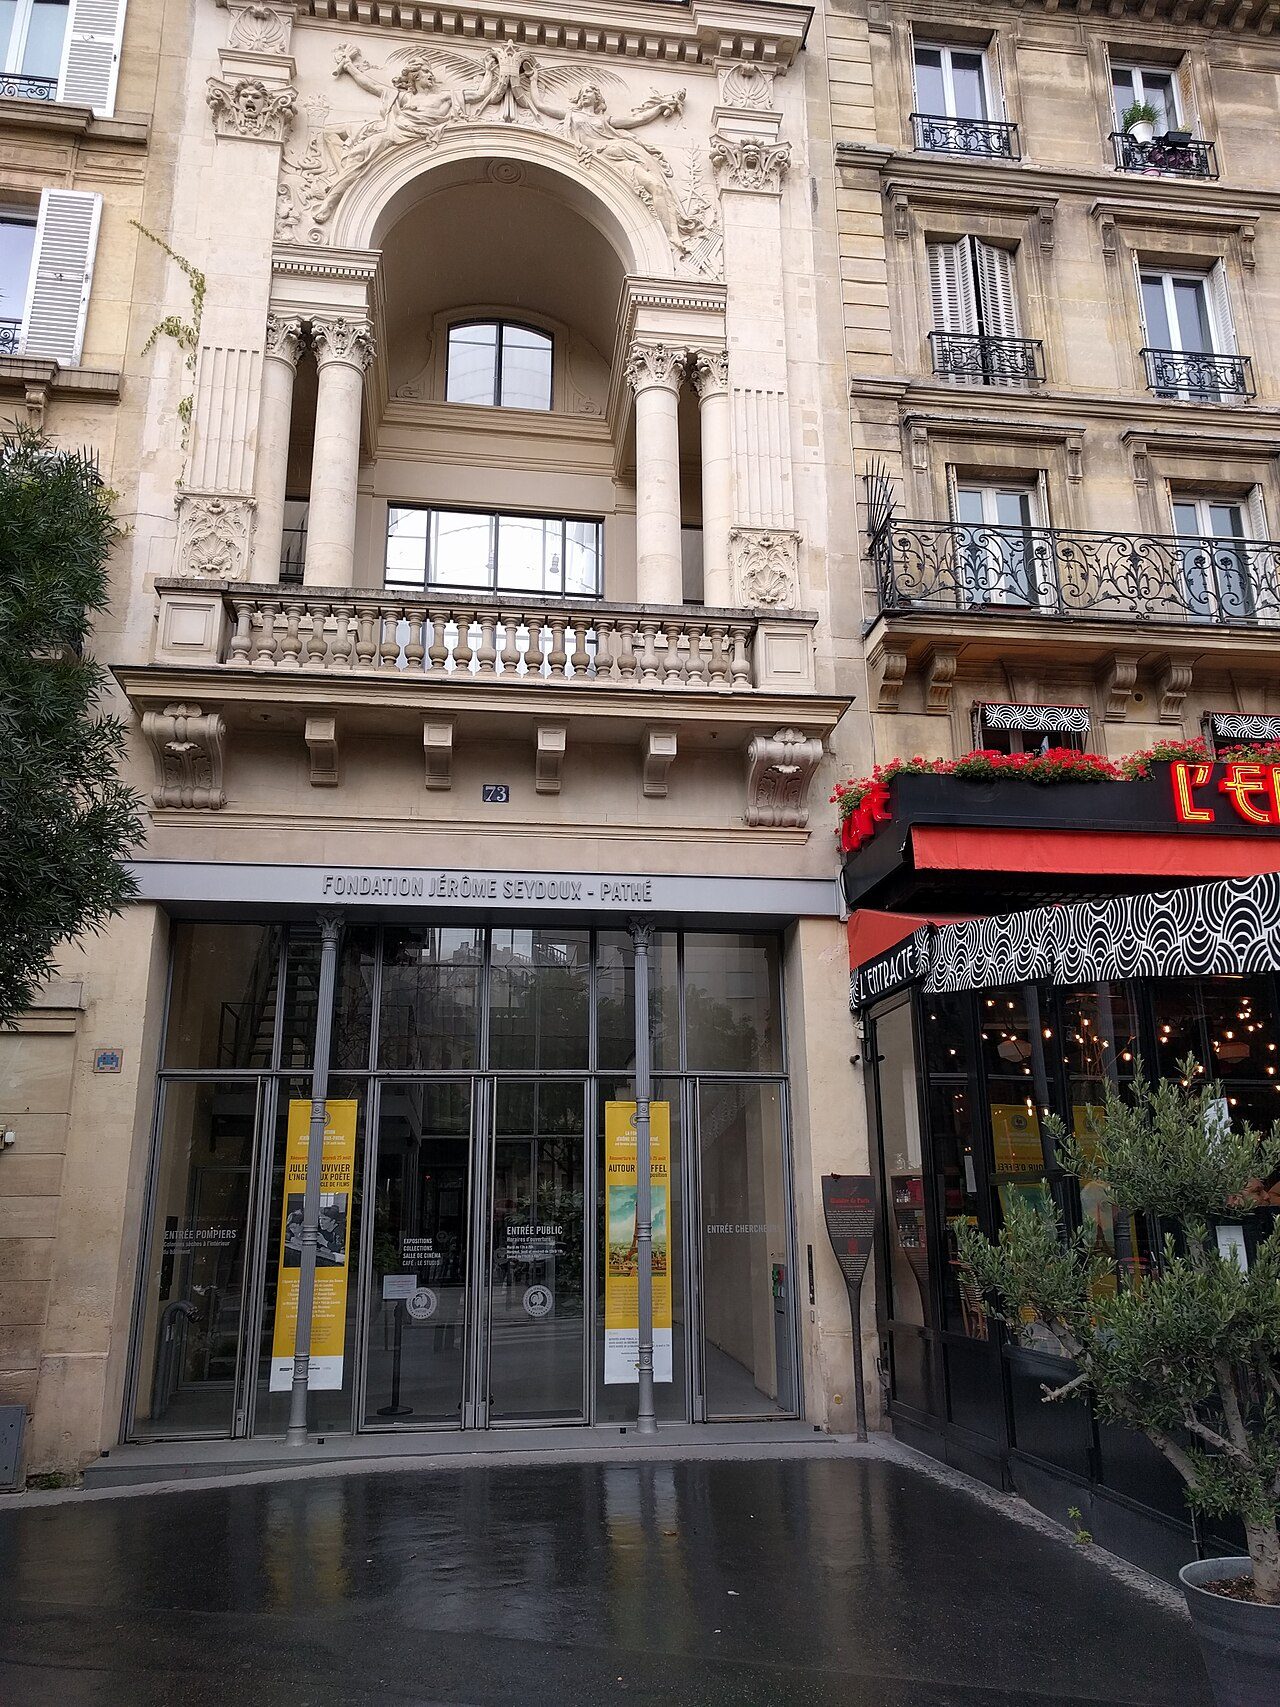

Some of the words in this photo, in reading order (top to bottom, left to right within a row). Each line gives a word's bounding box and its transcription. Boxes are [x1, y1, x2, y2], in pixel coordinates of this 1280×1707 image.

[485, 785, 507, 802] 73
[1170, 760, 1280, 826] L'E
[322, 874, 423, 897] FONDATION
[428, 873, 497, 899] JÉRÔME
[503, 879, 582, 901] SEYDOUX
[600, 880, 653, 902] PATHÉ
[859, 944, 914, 1000] L'ENTRACTE
[289, 1164, 308, 1172] JULIE
[321, 1163, 350, 1172] UVIVIER
[608, 1164, 635, 1172] AUTOUR
[650, 1164, 667, 1172] FFEL
[164, 1228, 194, 1239] ENTRÉE
[196, 1229, 237, 1239] POMPIERS
[507, 1224, 534, 1235] ENTRÉE
[536, 1225, 563, 1235] PUBLIC
[707, 1223, 734, 1234] ENTRÉE
[423, 1251, 442, 1259] CINÉMA
